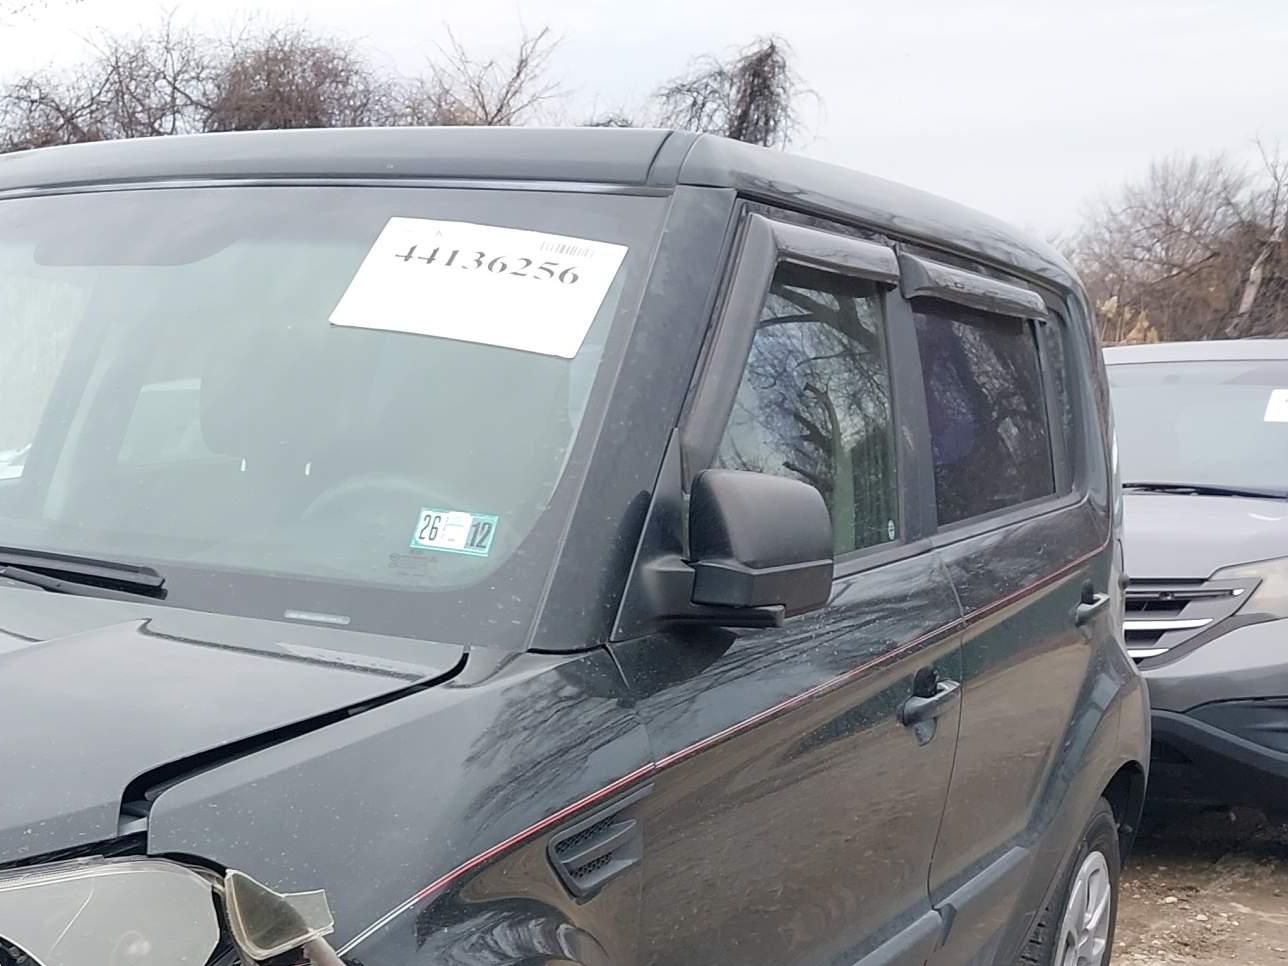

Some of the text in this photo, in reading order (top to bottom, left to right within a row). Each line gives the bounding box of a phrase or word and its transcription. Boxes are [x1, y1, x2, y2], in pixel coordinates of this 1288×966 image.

[394, 243, 581, 286] 44136256
[418, 514, 442, 541] 26
[469, 522, 494, 548] 12
